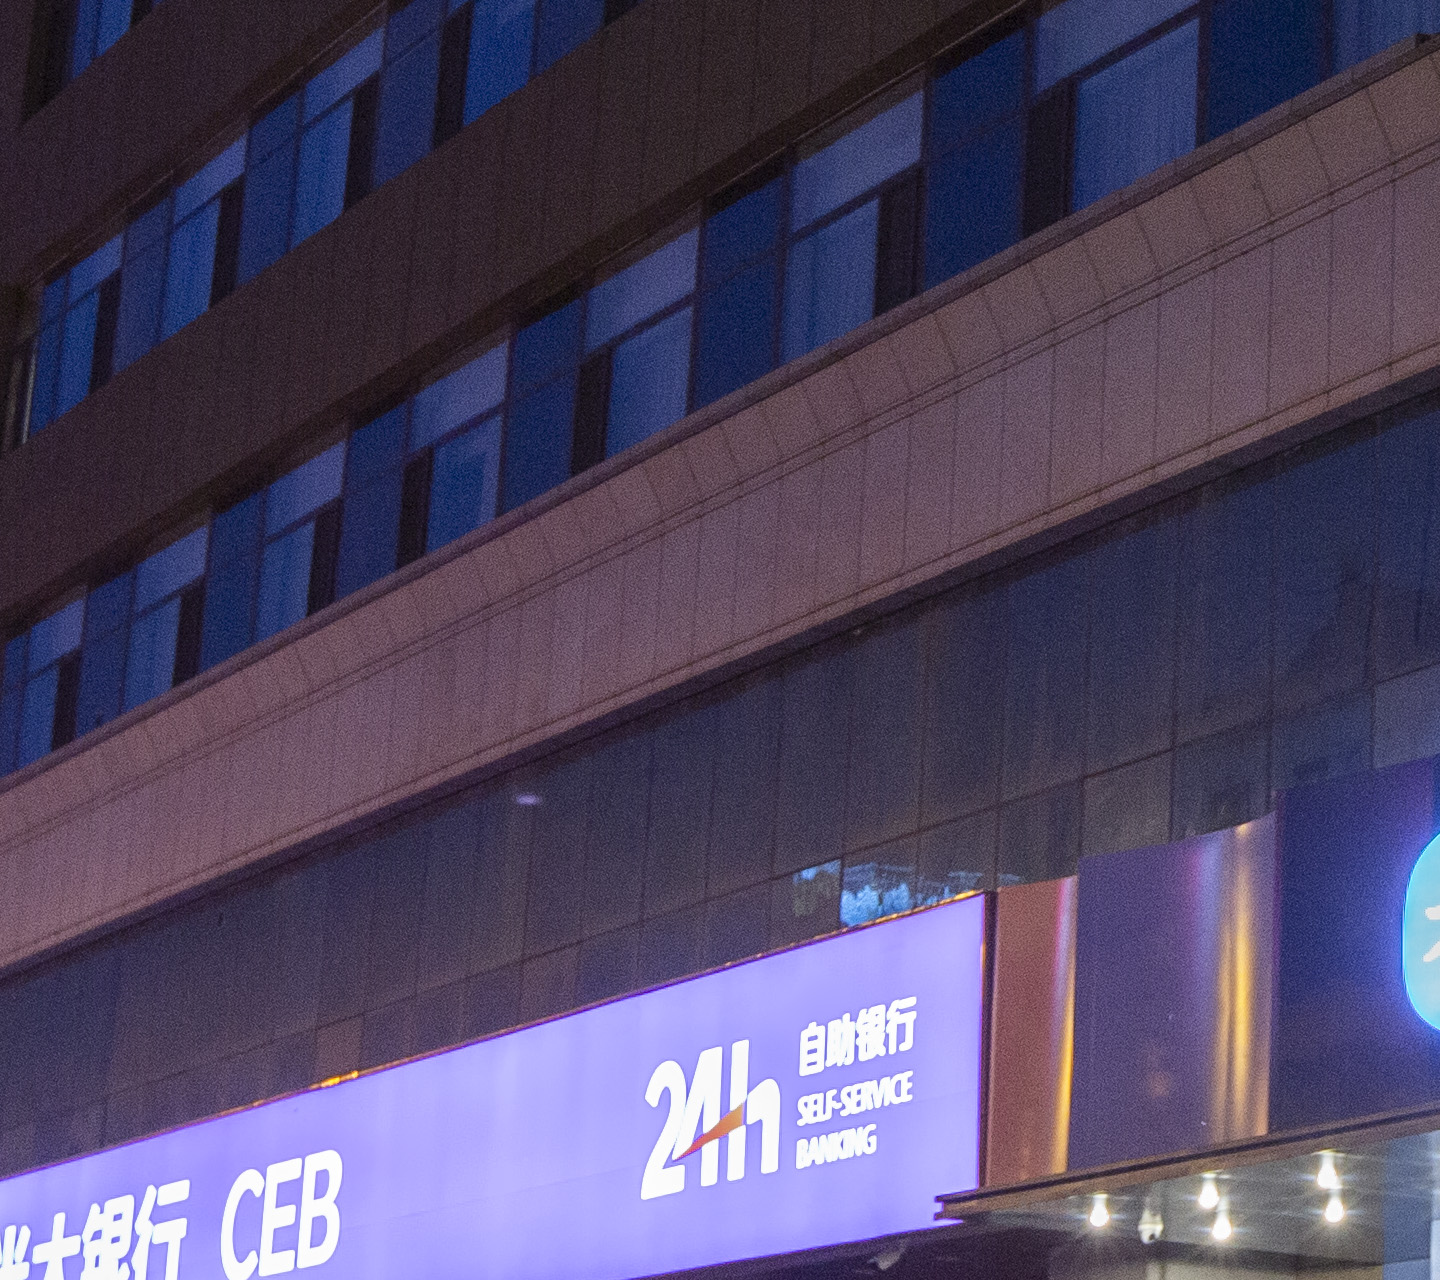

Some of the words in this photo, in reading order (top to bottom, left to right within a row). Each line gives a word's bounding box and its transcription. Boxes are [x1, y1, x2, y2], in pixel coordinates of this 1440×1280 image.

[799, 996, 917, 1077] 自助银行
[640, 1039, 781, 1201] 24h
[796, 1070, 914, 1126] SELF-SERVICE
[796, 1124, 877, 1170] BANKING
